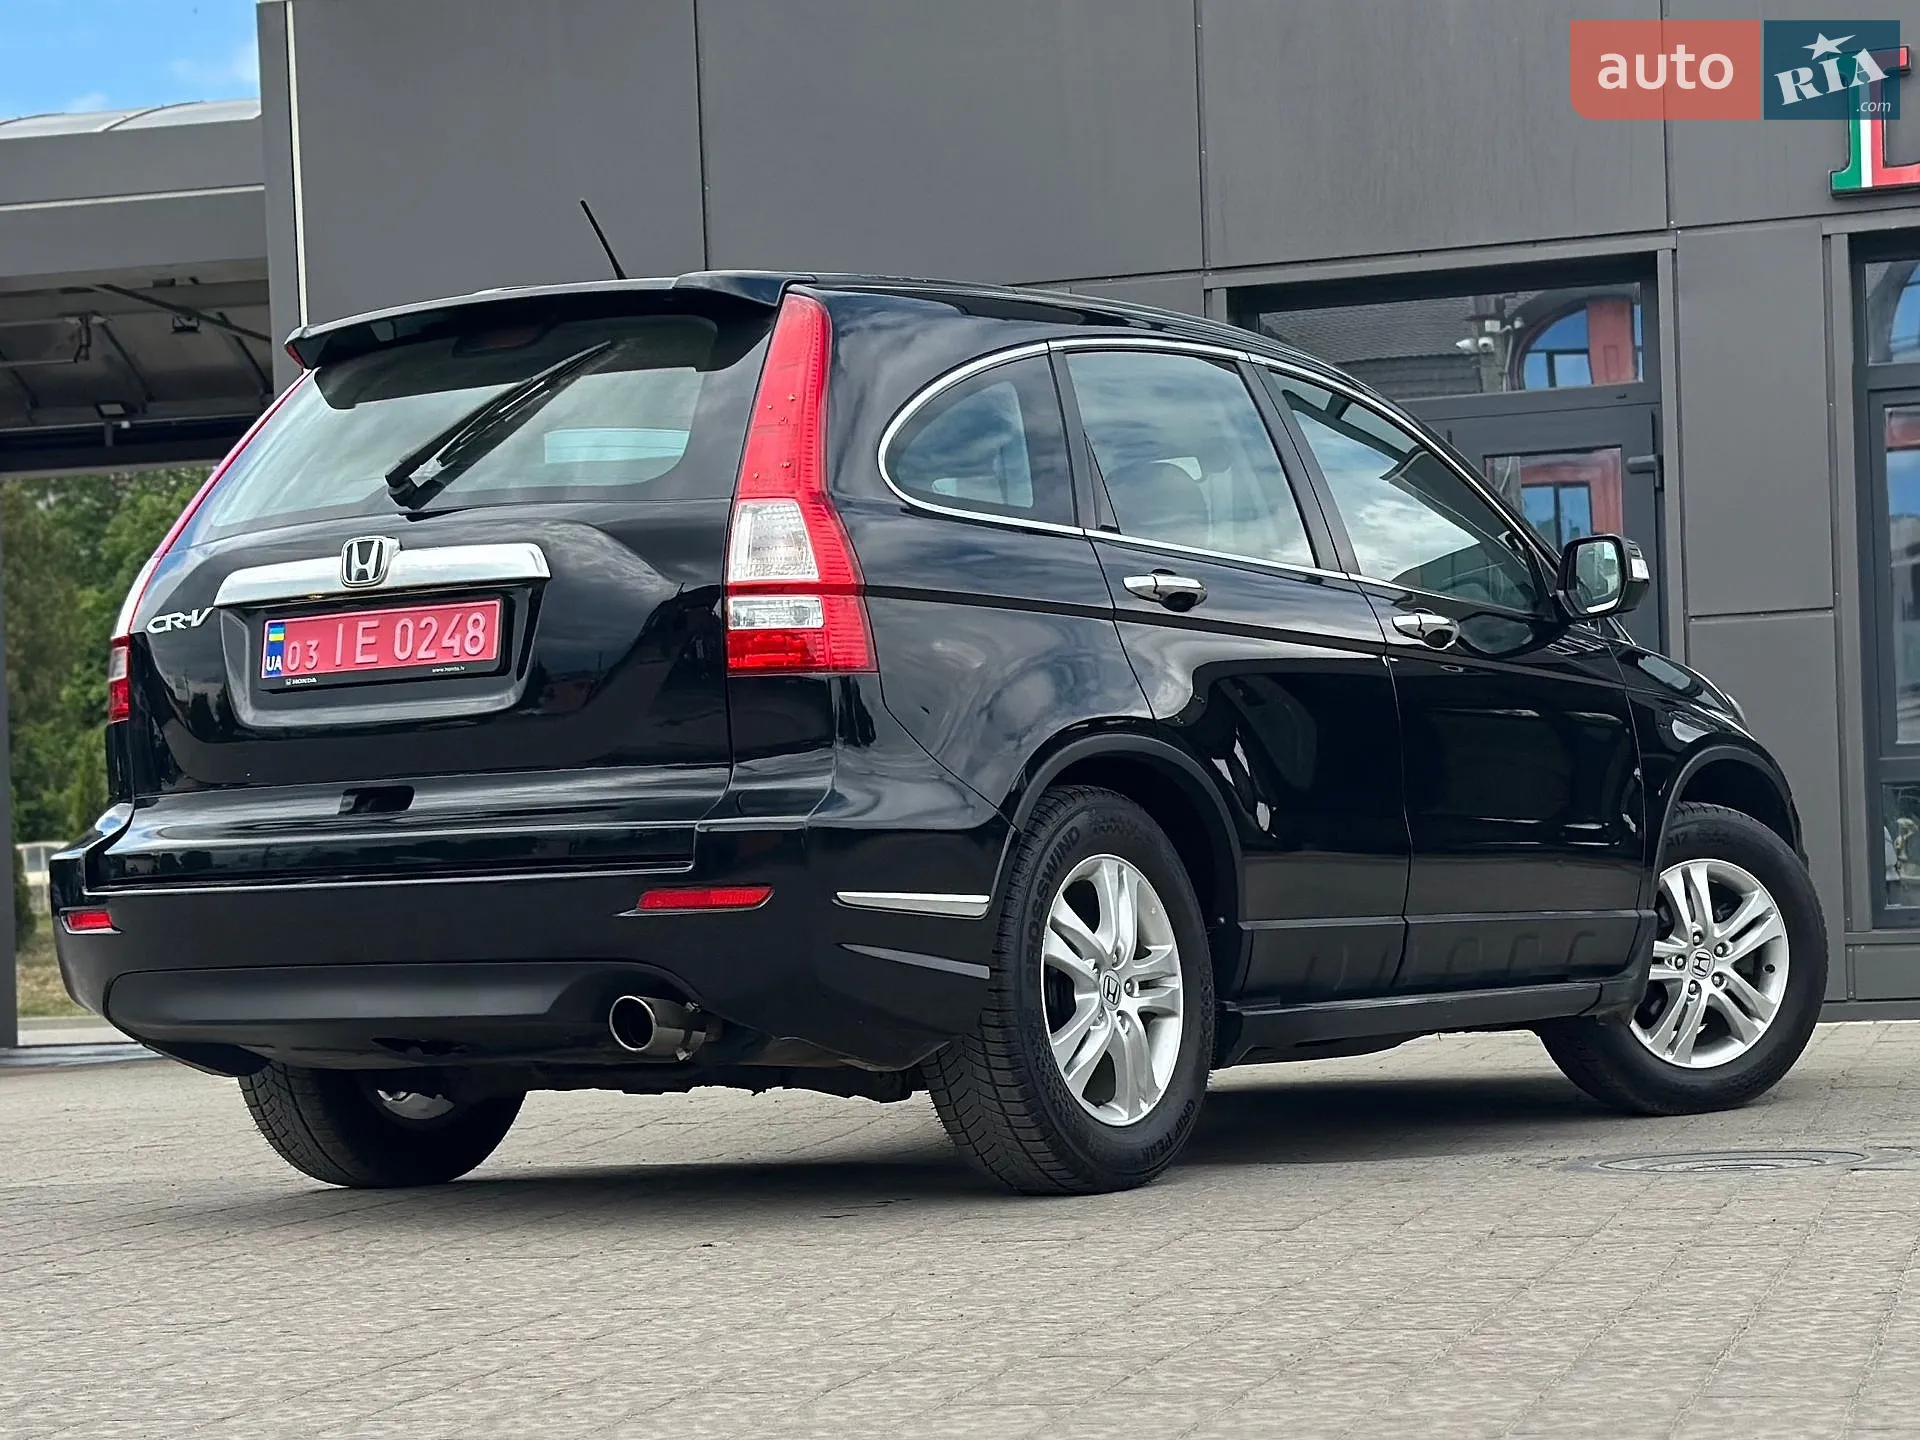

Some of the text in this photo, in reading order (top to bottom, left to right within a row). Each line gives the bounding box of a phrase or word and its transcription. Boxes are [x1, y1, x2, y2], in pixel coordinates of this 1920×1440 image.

[146, 606, 214, 634] CR-V
[287, 611, 486, 672] 03 IE 0248
[265, 655, 282, 671] UA
[1025, 826, 1081, 988] CROSSWIND
